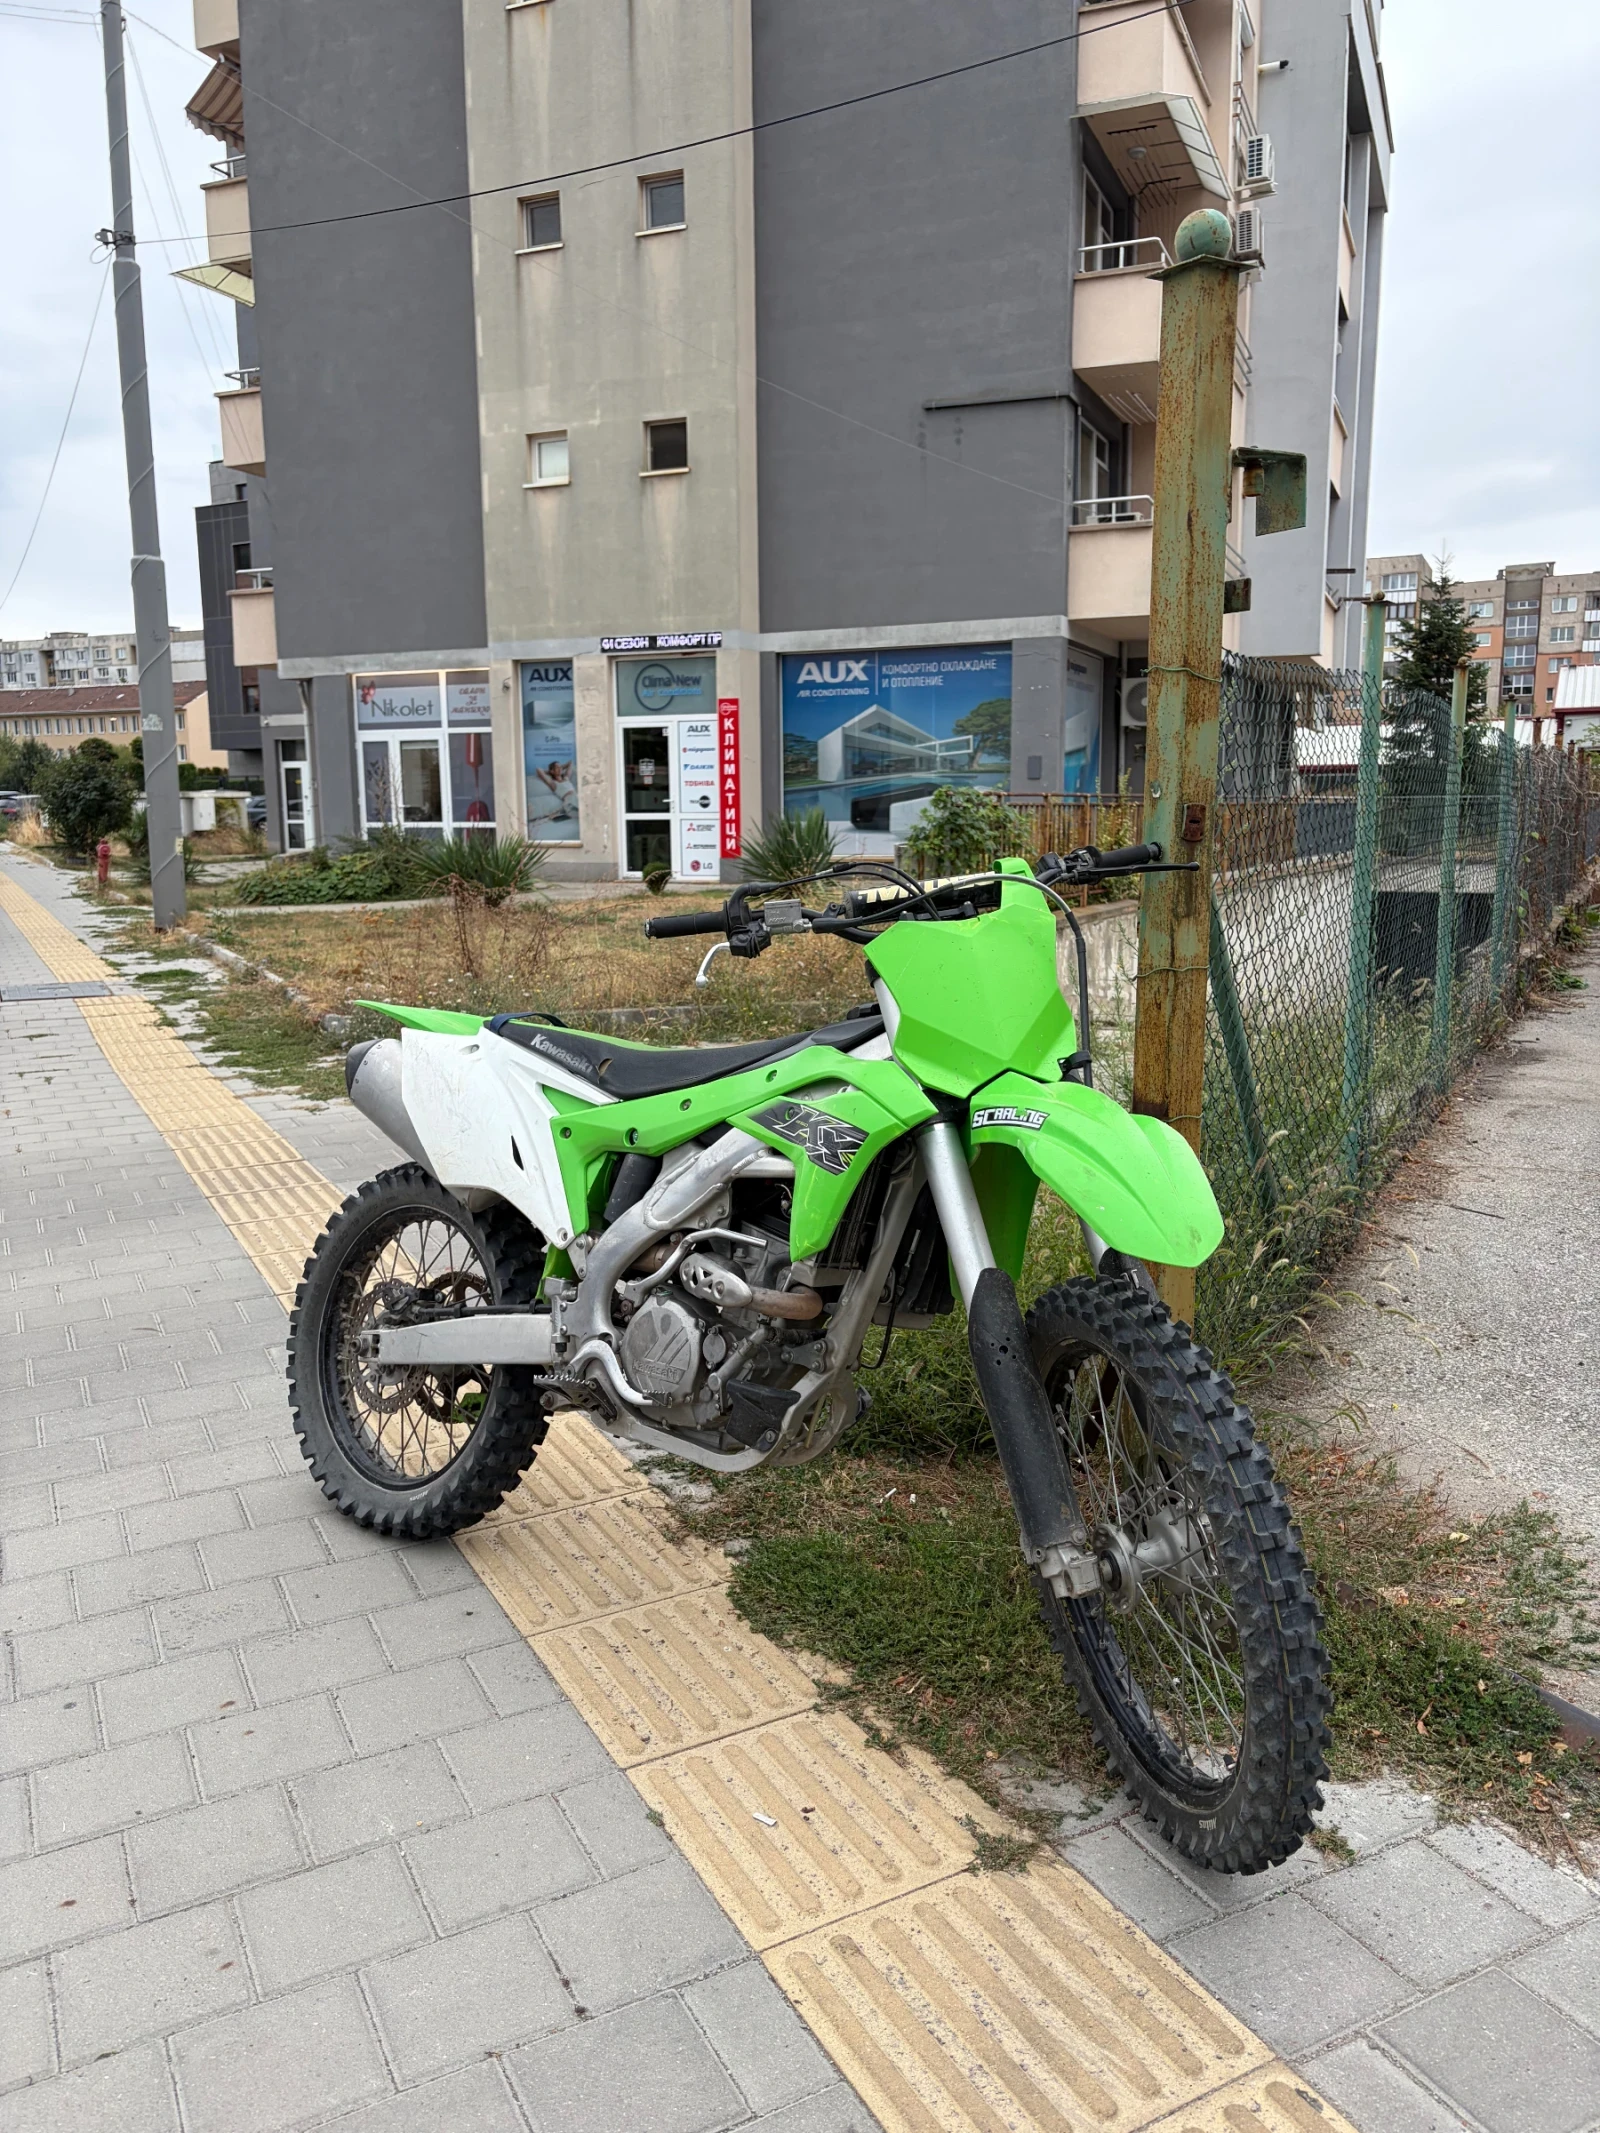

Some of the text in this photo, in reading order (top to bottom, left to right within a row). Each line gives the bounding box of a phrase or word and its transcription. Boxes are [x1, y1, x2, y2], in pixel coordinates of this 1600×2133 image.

[528, 667, 573, 683] AUX
[797, 659, 869, 684] AUX
[881, 659, 997, 675] КОМФОРТНО ОХЛАЖДАНЕ
[881, 675, 944, 688] И ОТОПЛЕНИЕ
[812, 687, 869, 697] CONDITIONING
[370, 698, 433, 717] Nikolet
[687, 724, 711, 733] AUX
[723, 717, 737, 851] КЛИМАТИЦИ
[702, 862, 714, 870] LG
[530, 1033, 593, 1073] Kawasaki
